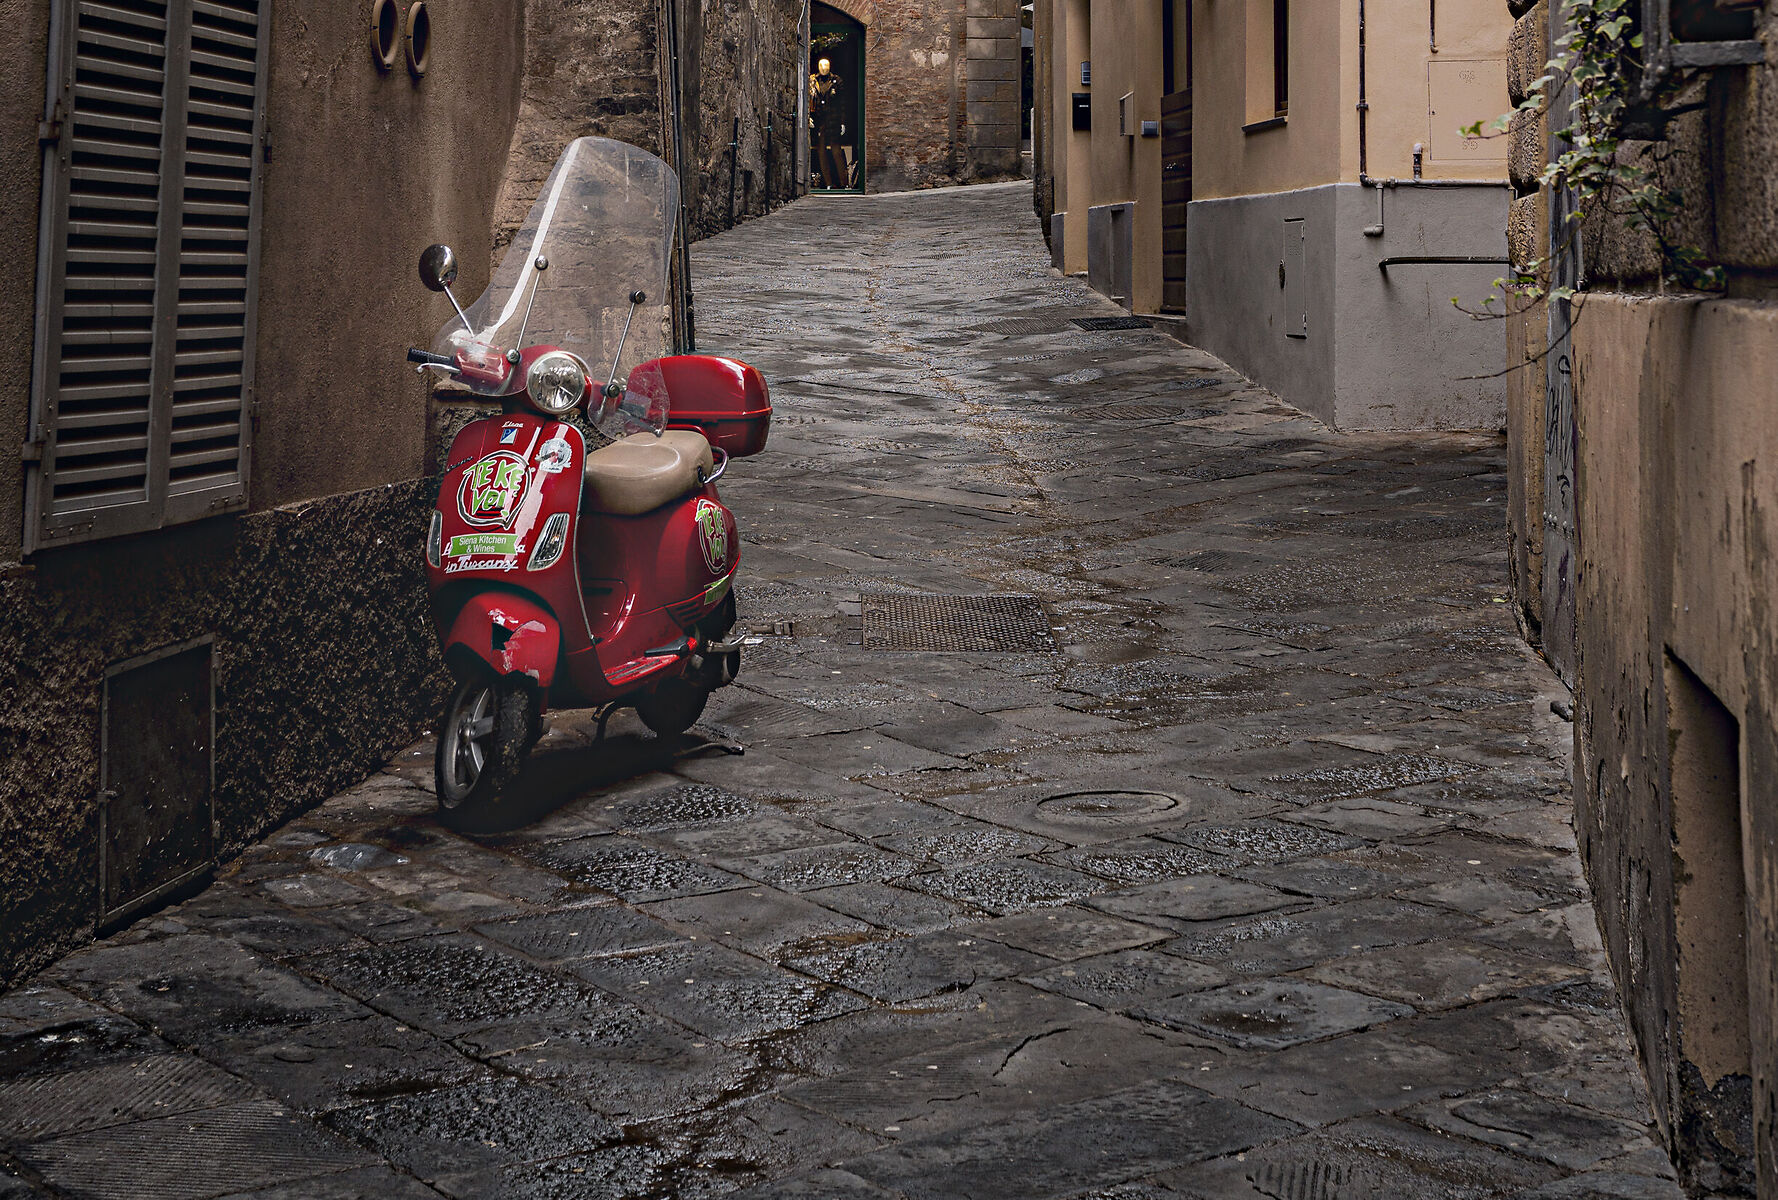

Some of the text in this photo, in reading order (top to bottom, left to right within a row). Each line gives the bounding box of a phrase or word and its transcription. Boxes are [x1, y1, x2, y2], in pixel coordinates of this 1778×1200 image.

[463, 460, 497, 489] TE
[493, 460, 524, 490] KE
[459, 535, 507, 546] Siena Kitchen
[473, 544, 495, 552] Wines
[444, 555, 518, 573] in Tuscany
